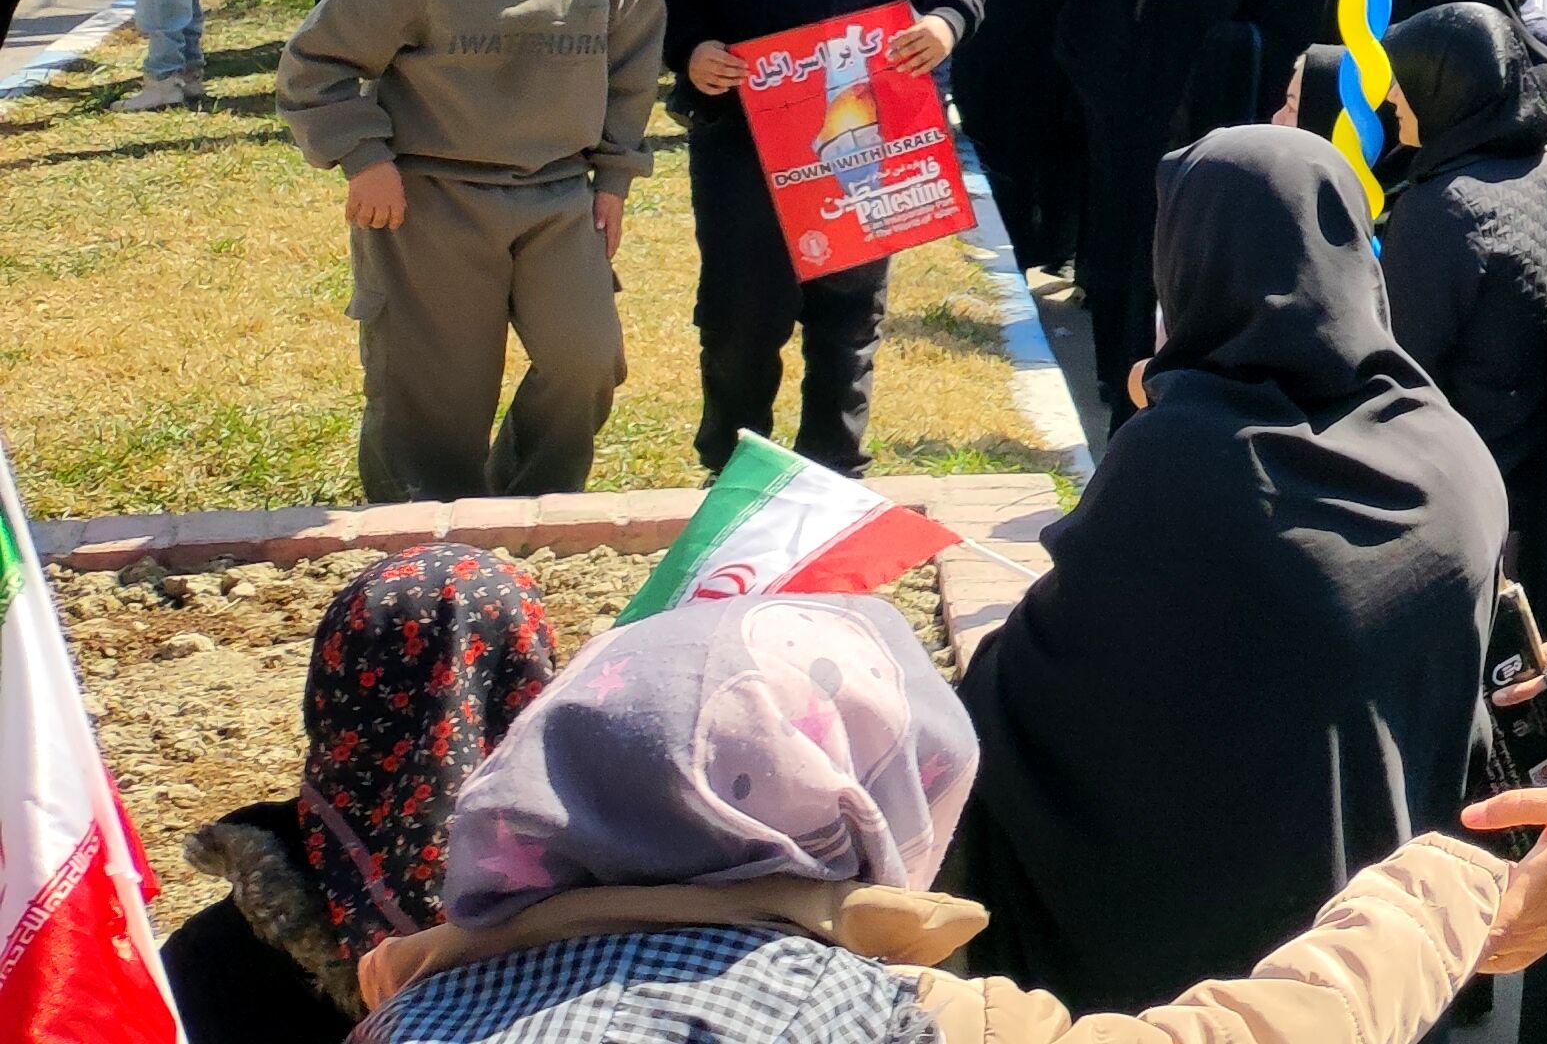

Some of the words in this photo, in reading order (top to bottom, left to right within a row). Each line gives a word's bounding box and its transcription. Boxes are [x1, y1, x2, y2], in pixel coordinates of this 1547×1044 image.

[749, 40, 829, 90] اسرائیل
[773, 161, 833, 188] DOWN
[834, 147, 881, 171] WITH
[885, 129, 945, 157] ISRAEL
[820, 155, 942, 220] فلسطین
[854, 178, 953, 225] Palestine
